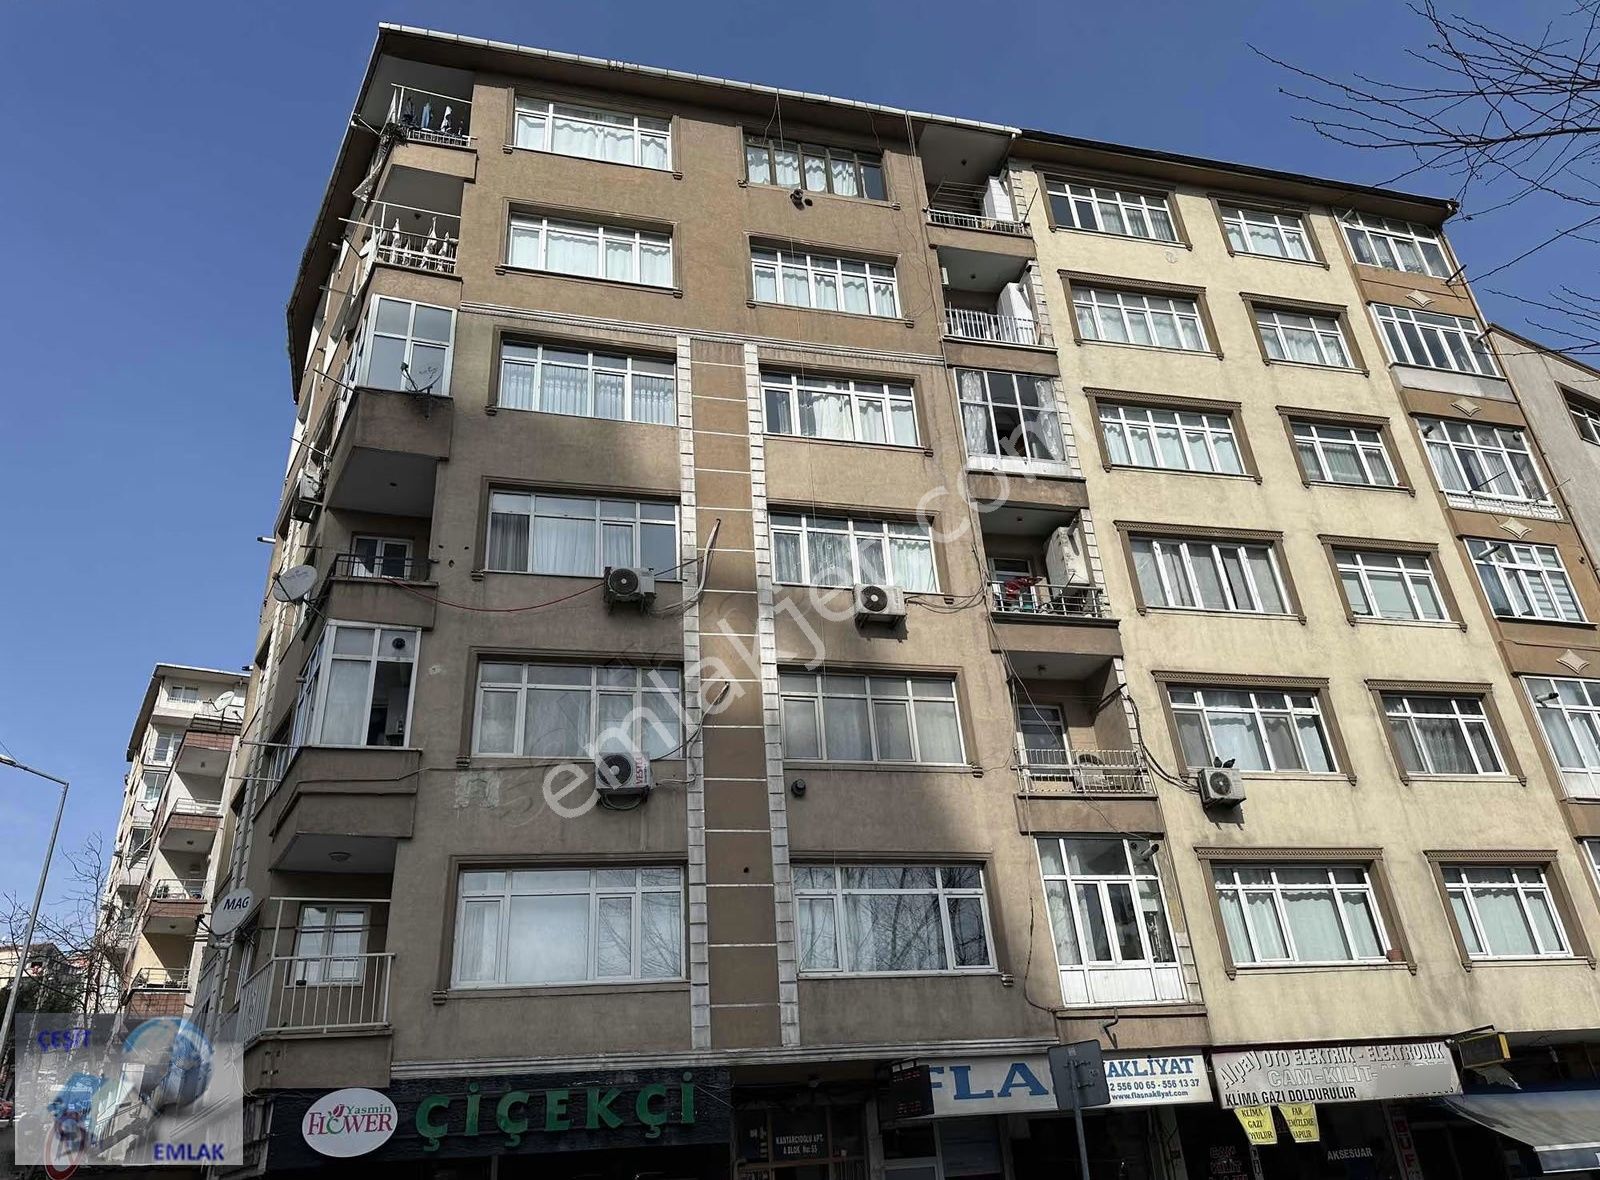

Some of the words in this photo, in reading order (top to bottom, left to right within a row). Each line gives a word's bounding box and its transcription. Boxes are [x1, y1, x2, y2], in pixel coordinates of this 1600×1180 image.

[223, 896, 250, 911] MAG
[1104, 1055, 1194, 1077] AKLİYAT
[1263, 1050, 1291, 1067] OTO
[928, 1062, 1049, 1100] FLA
[1117, 1082, 1132, 1091] 556
[1134, 1082, 1144, 1090] 00
[1146, 1081, 1156, 1089] 65
[1179, 1079, 1188, 1088] 13
[1191, 1078, 1200, 1087] 37
[1225, 1090, 1260, 1107] KLİMA
[1261, 1090, 1286, 1104] GAZI
[1288, 1086, 1357, 1102] DOLDURULUR
[346, 1104, 391, 1115] Yasmin
[415, 1071, 696, 1151] ÇİÇEKÇİ
[1291, 1107, 1303, 1116] FAR
[307, 1109, 393, 1136] FLOWER
[1247, 1120, 1263, 1129] GAZI
[1288, 1117, 1314, 1127] EMİZLEME
[1327, 1147, 1373, 1161] AKSESUAR
